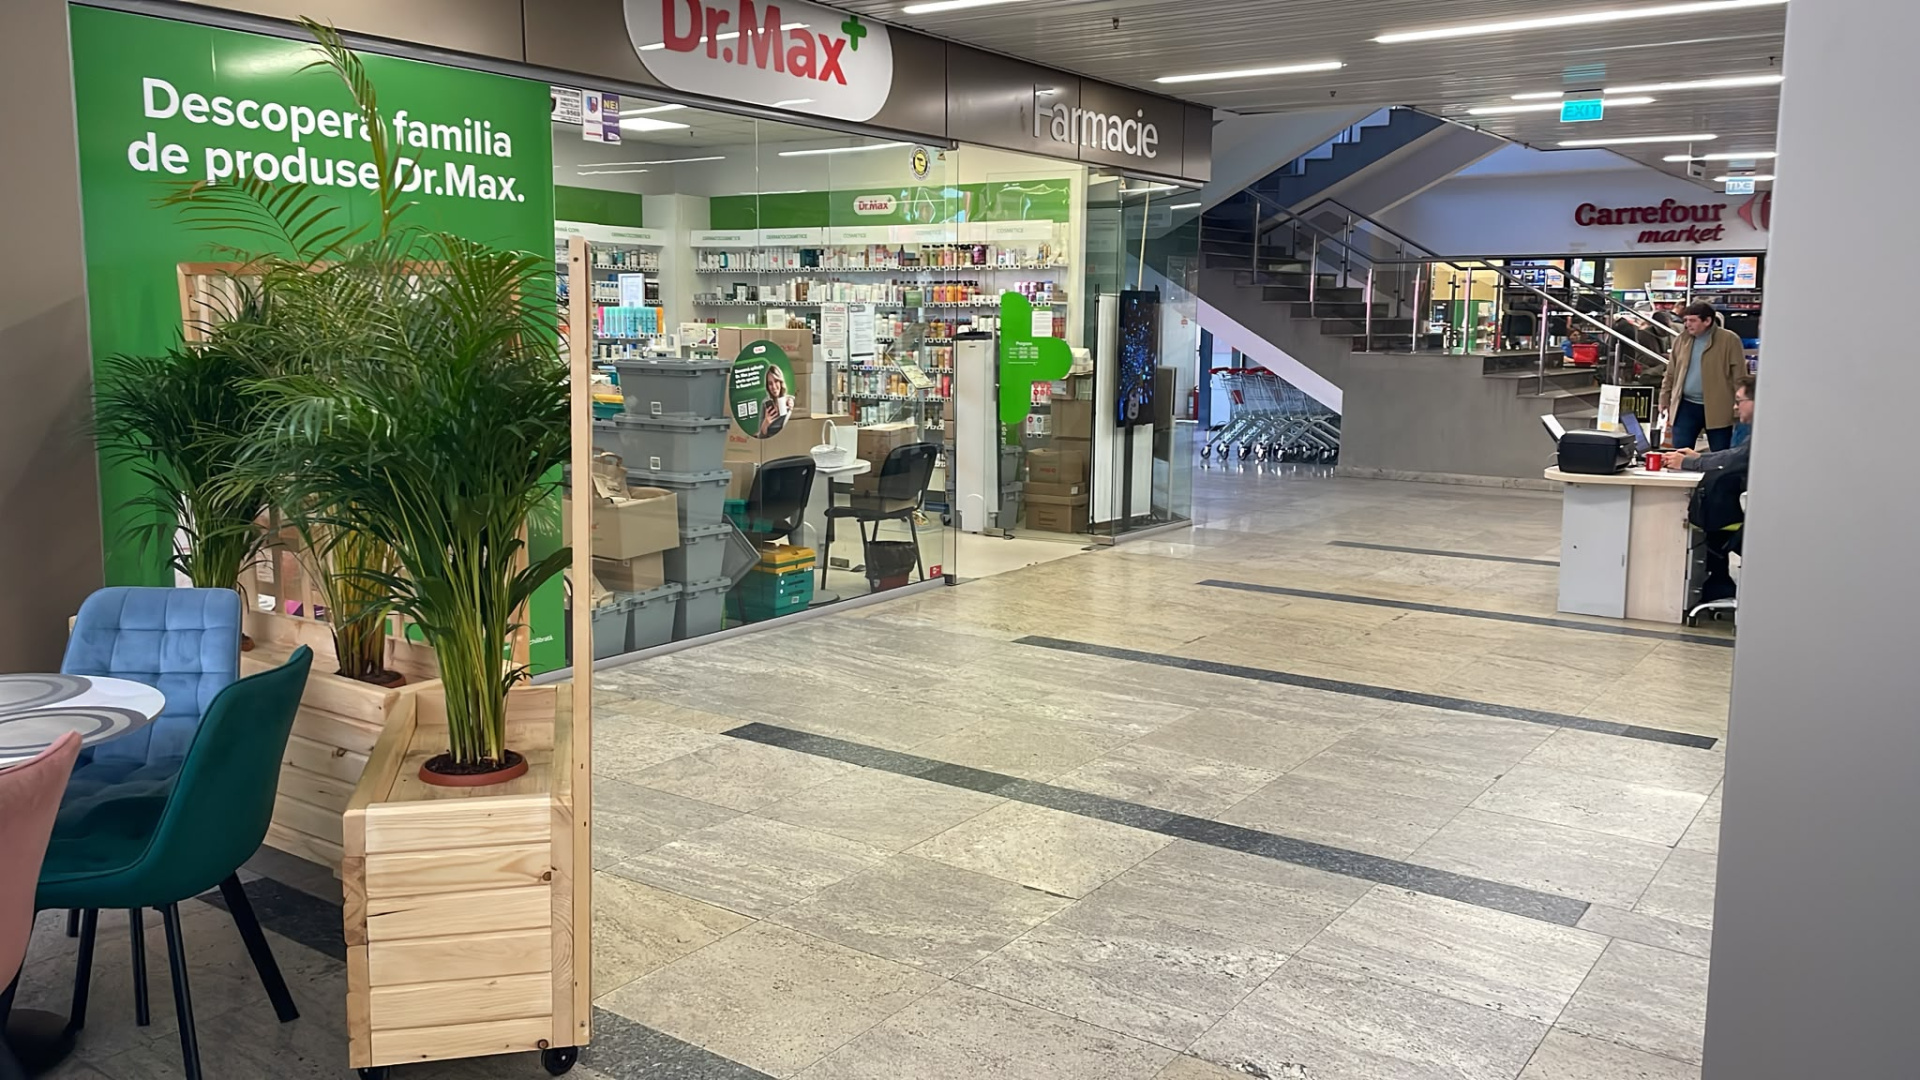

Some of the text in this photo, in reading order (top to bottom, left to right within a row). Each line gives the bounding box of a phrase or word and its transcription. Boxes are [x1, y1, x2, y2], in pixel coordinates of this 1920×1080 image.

[661, 0, 847, 86] Dr.Max
[1033, 82, 1159, 159] Farmacie
[1563, 104, 1602, 119] EXIT
[392, 110, 512, 158] familia
[127, 131, 526, 203] de produse Dr.Max.
[858, 200, 889, 211] Dr.Max
[1574, 198, 1727, 227] Carrefour
[1637, 223, 1725, 244] market
